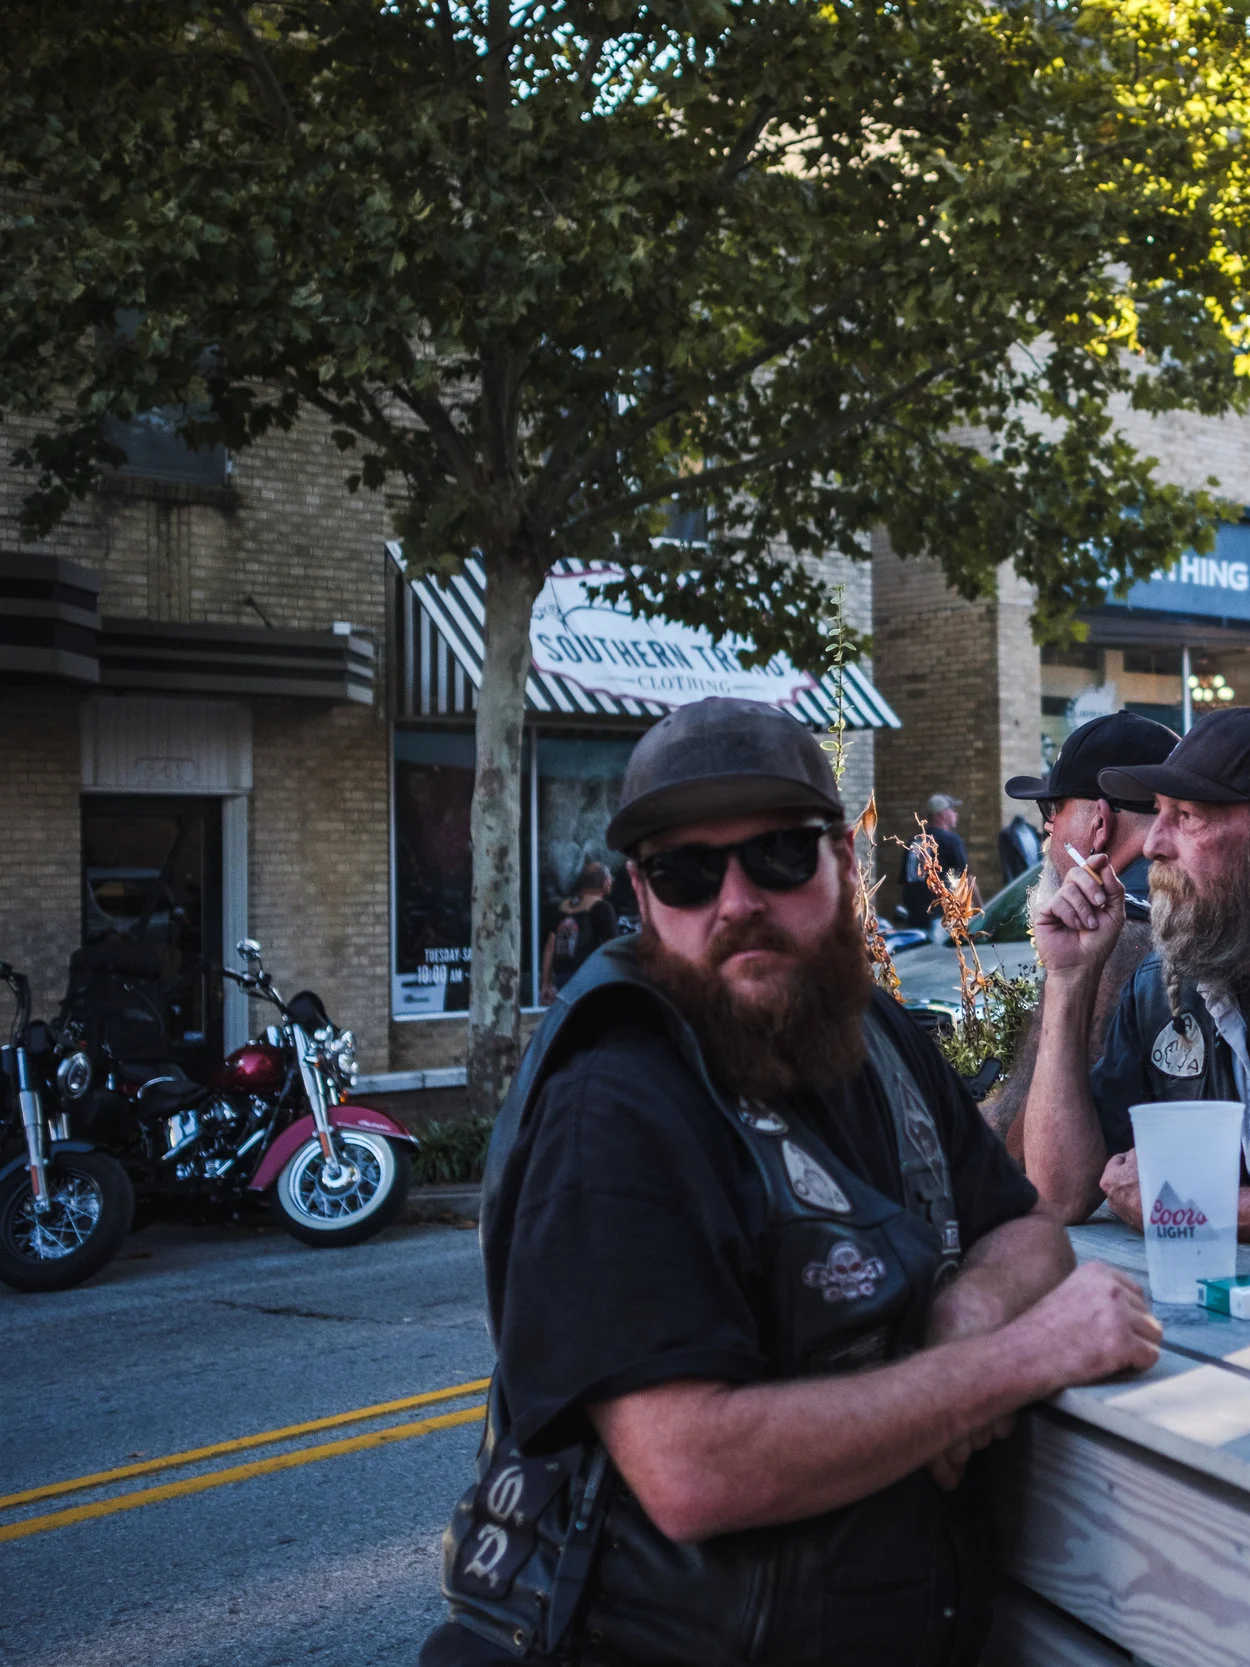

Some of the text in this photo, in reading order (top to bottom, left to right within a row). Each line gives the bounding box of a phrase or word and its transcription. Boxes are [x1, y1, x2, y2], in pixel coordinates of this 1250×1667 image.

[537, 633, 694, 671] SOUTHERN
[637, 676, 731, 694] CLOTHING
[1150, 1199, 1208, 1226] Coors
[1157, 1226, 1197, 1239] LIGHT
